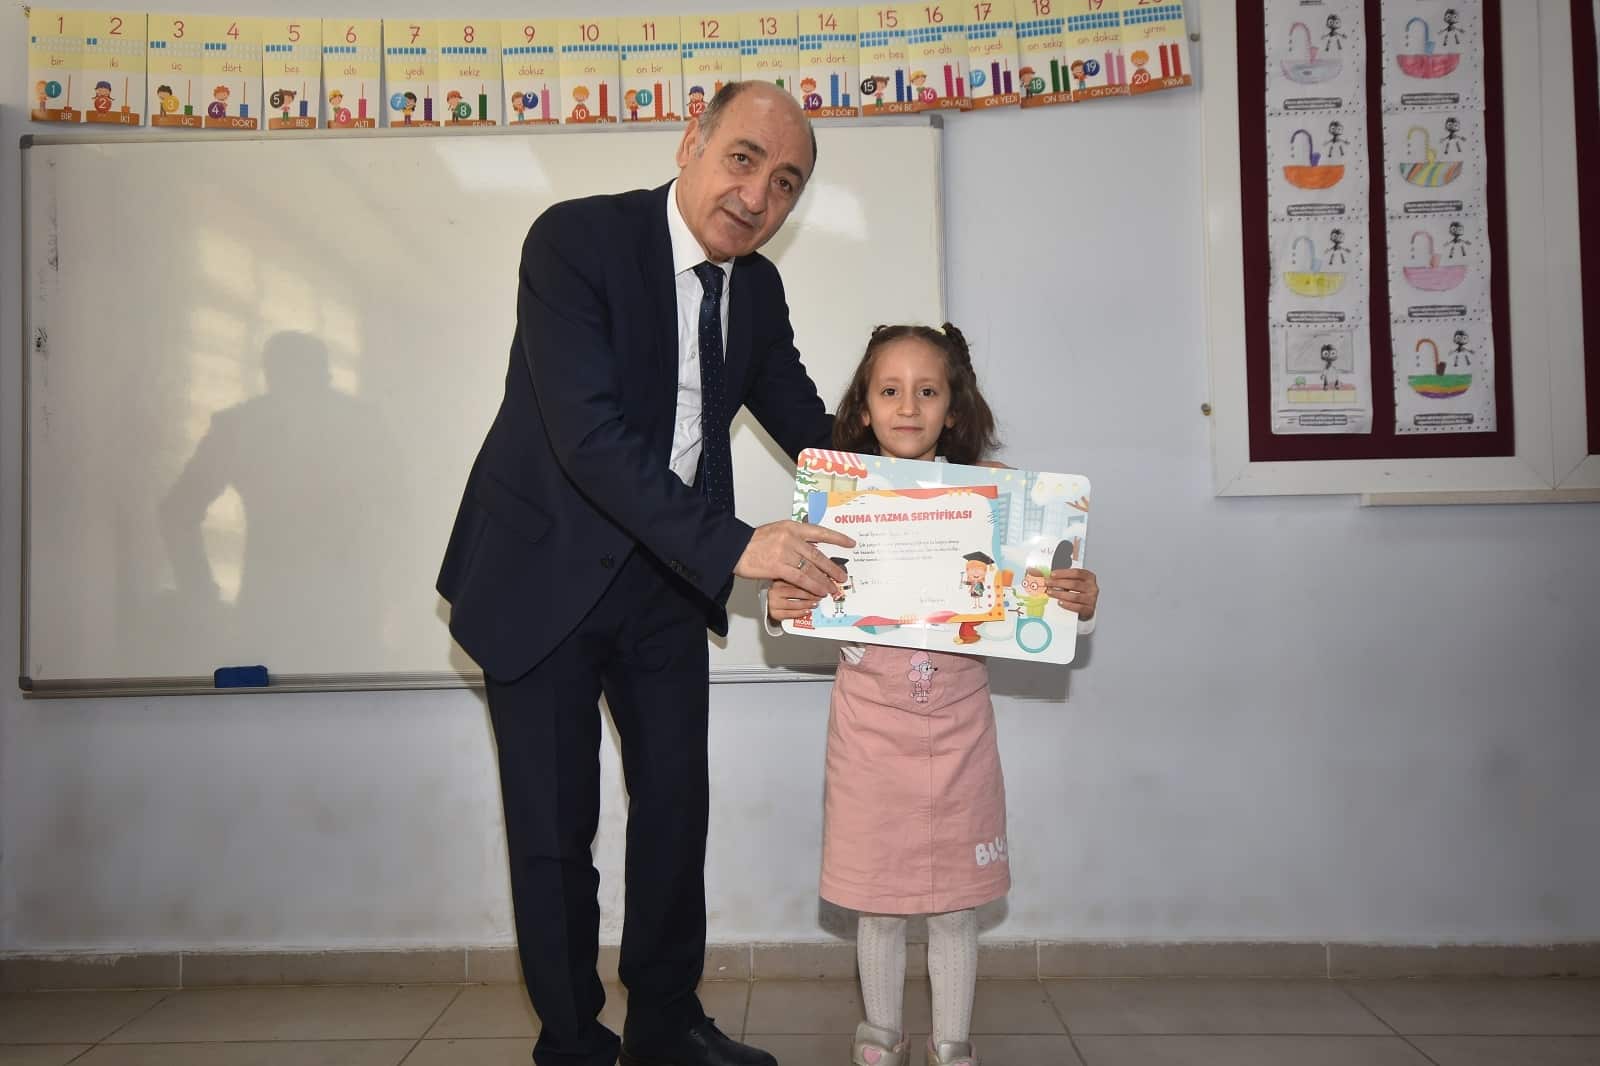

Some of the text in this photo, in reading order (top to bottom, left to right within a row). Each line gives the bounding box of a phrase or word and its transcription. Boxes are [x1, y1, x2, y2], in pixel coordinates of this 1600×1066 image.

[974, 3, 992, 21] 17
[1032, 0, 1051, 16] 18
[877, 10, 898, 29] 15
[924, 6, 944, 24] 16
[57, 16, 64, 34] 1
[109, 17, 123, 35] 2
[759, 17, 778, 36] 13
[818, 13, 838, 31] 14
[173, 20, 185, 39] 3
[226, 22, 240, 40] 4
[288, 24, 301, 42] 5
[345, 25, 357, 44] 6
[409, 26, 421, 44] 7
[463, 25, 475, 44] 8
[524, 25, 536, 44] 9
[579, 24, 600, 42] 10
[642, 22, 656, 41] 11
[700, 20, 720, 39] 12
[1077, 32, 1120, 44] on dokuz
[923, 47, 936, 56] on
[969, 45, 981, 53] on
[1028, 43, 1040, 51] on
[873, 52, 886, 60] on
[518, 64, 545, 76] dokuz
[636, 66, 648, 74] on
[698, 63, 711, 72] on
[1085, 61, 1097, 72] 19
[974, 73, 984, 84] 17
[1133, 73, 1149, 86] 20
[863, 81, 874, 92] 15
[1031, 79, 1042, 91] 18
[526, 93, 533, 103] 9
[640, 92, 648, 104] 11
[923, 89, 934, 100] 16
[1091, 88, 1104, 97] ON
[100, 99, 108, 109] 2
[273, 95, 281, 105] 5
[395, 96, 402, 105] 7
[808, 96, 819, 107] 14
[942, 99, 954, 107] ON
[985, 97, 999, 106] ON
[1044, 94, 1057, 103] ON
[167, 99, 175, 110] 3
[212, 104, 220, 115] 4
[692, 102, 703, 113] 12
[889, 103, 913, 112] ON BE
[340, 111, 346, 122] 6
[460, 105, 467, 117] 8
[574, 108, 586, 119] 10
[822, 109, 834, 117] ON
[834, 509, 973, 524] OKUMA YAZMA SERTİFİKASI
[976, 836, 1008, 866] BLU
